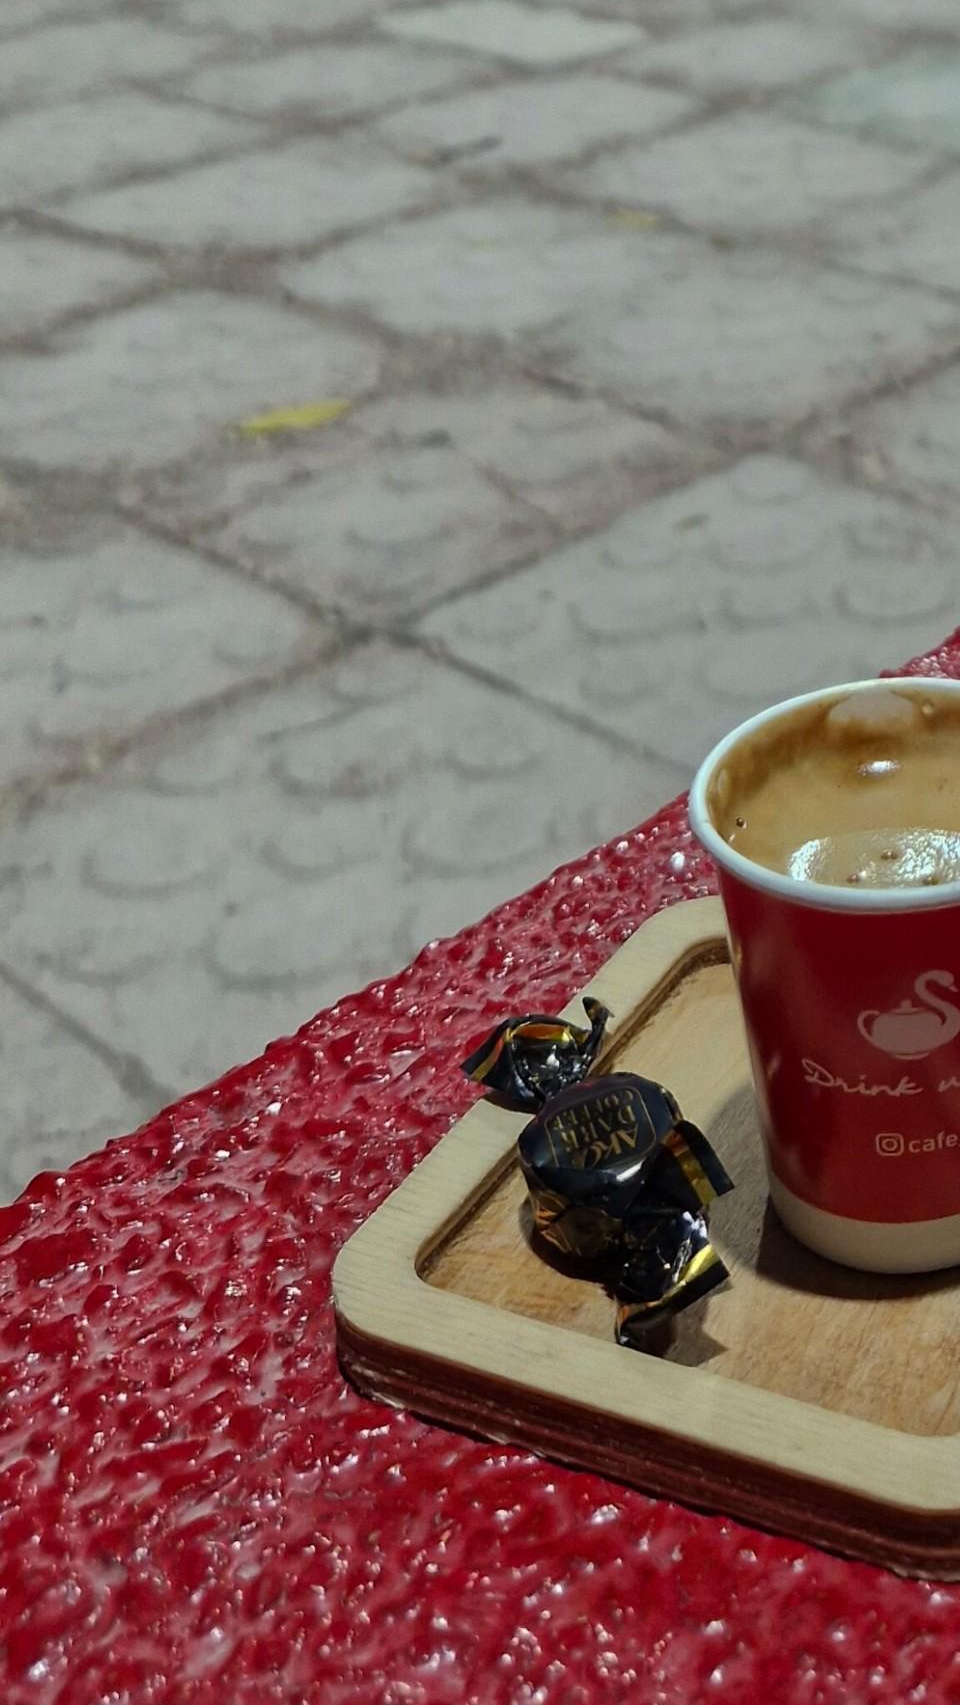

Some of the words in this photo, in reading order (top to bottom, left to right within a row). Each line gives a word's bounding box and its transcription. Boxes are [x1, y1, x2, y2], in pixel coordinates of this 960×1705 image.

[802, 1058, 923, 1097] Drink
[553, 1089, 634, 1131] COFFEE
[561, 1105, 636, 1153] DARK
